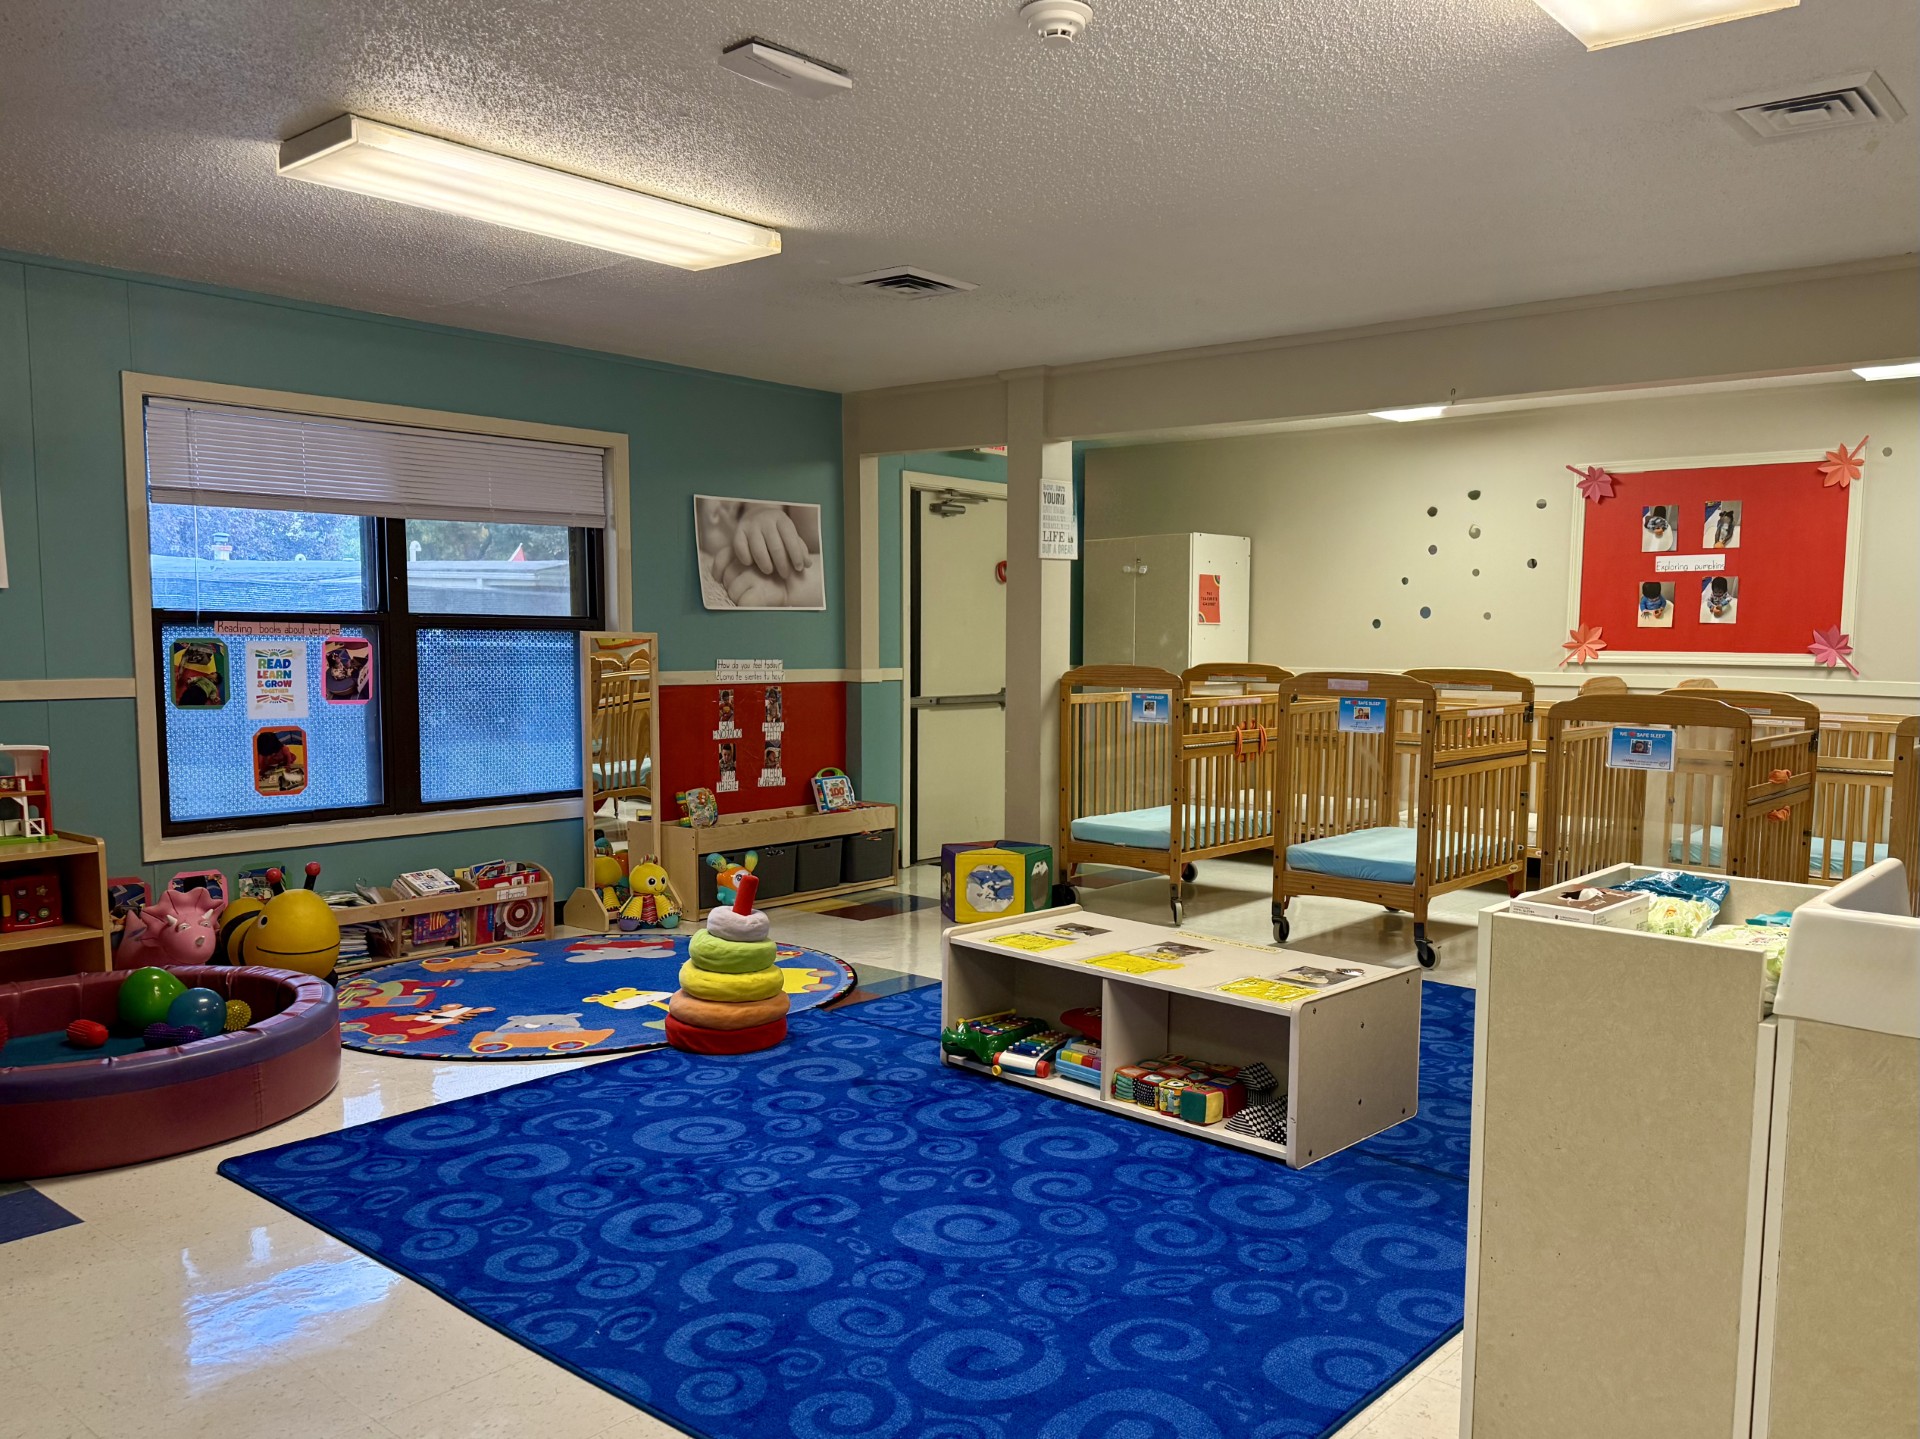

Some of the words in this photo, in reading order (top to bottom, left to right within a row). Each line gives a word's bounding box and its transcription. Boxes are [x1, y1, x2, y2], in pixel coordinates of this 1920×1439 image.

[1042, 531, 1065, 543] LIFE
[1656, 561, 1689, 572] Exploring
[217, 620, 253, 635] Reading
[259, 622, 282, 634] books
[284, 623, 305, 635] about
[308, 623, 340, 635] vehicles
[258, 658, 291, 669] READ
[717, 660, 731, 669] How
[732, 660, 739, 669] do
[741, 662, 751, 670] you
[753, 658, 762, 669] feel
[257, 670, 292, 679] LEARN
[736, 670, 742, 681] te
[257, 680, 264, 688] &
[264, 680, 292, 688] GROW
[830, 787, 845, 797] 100
